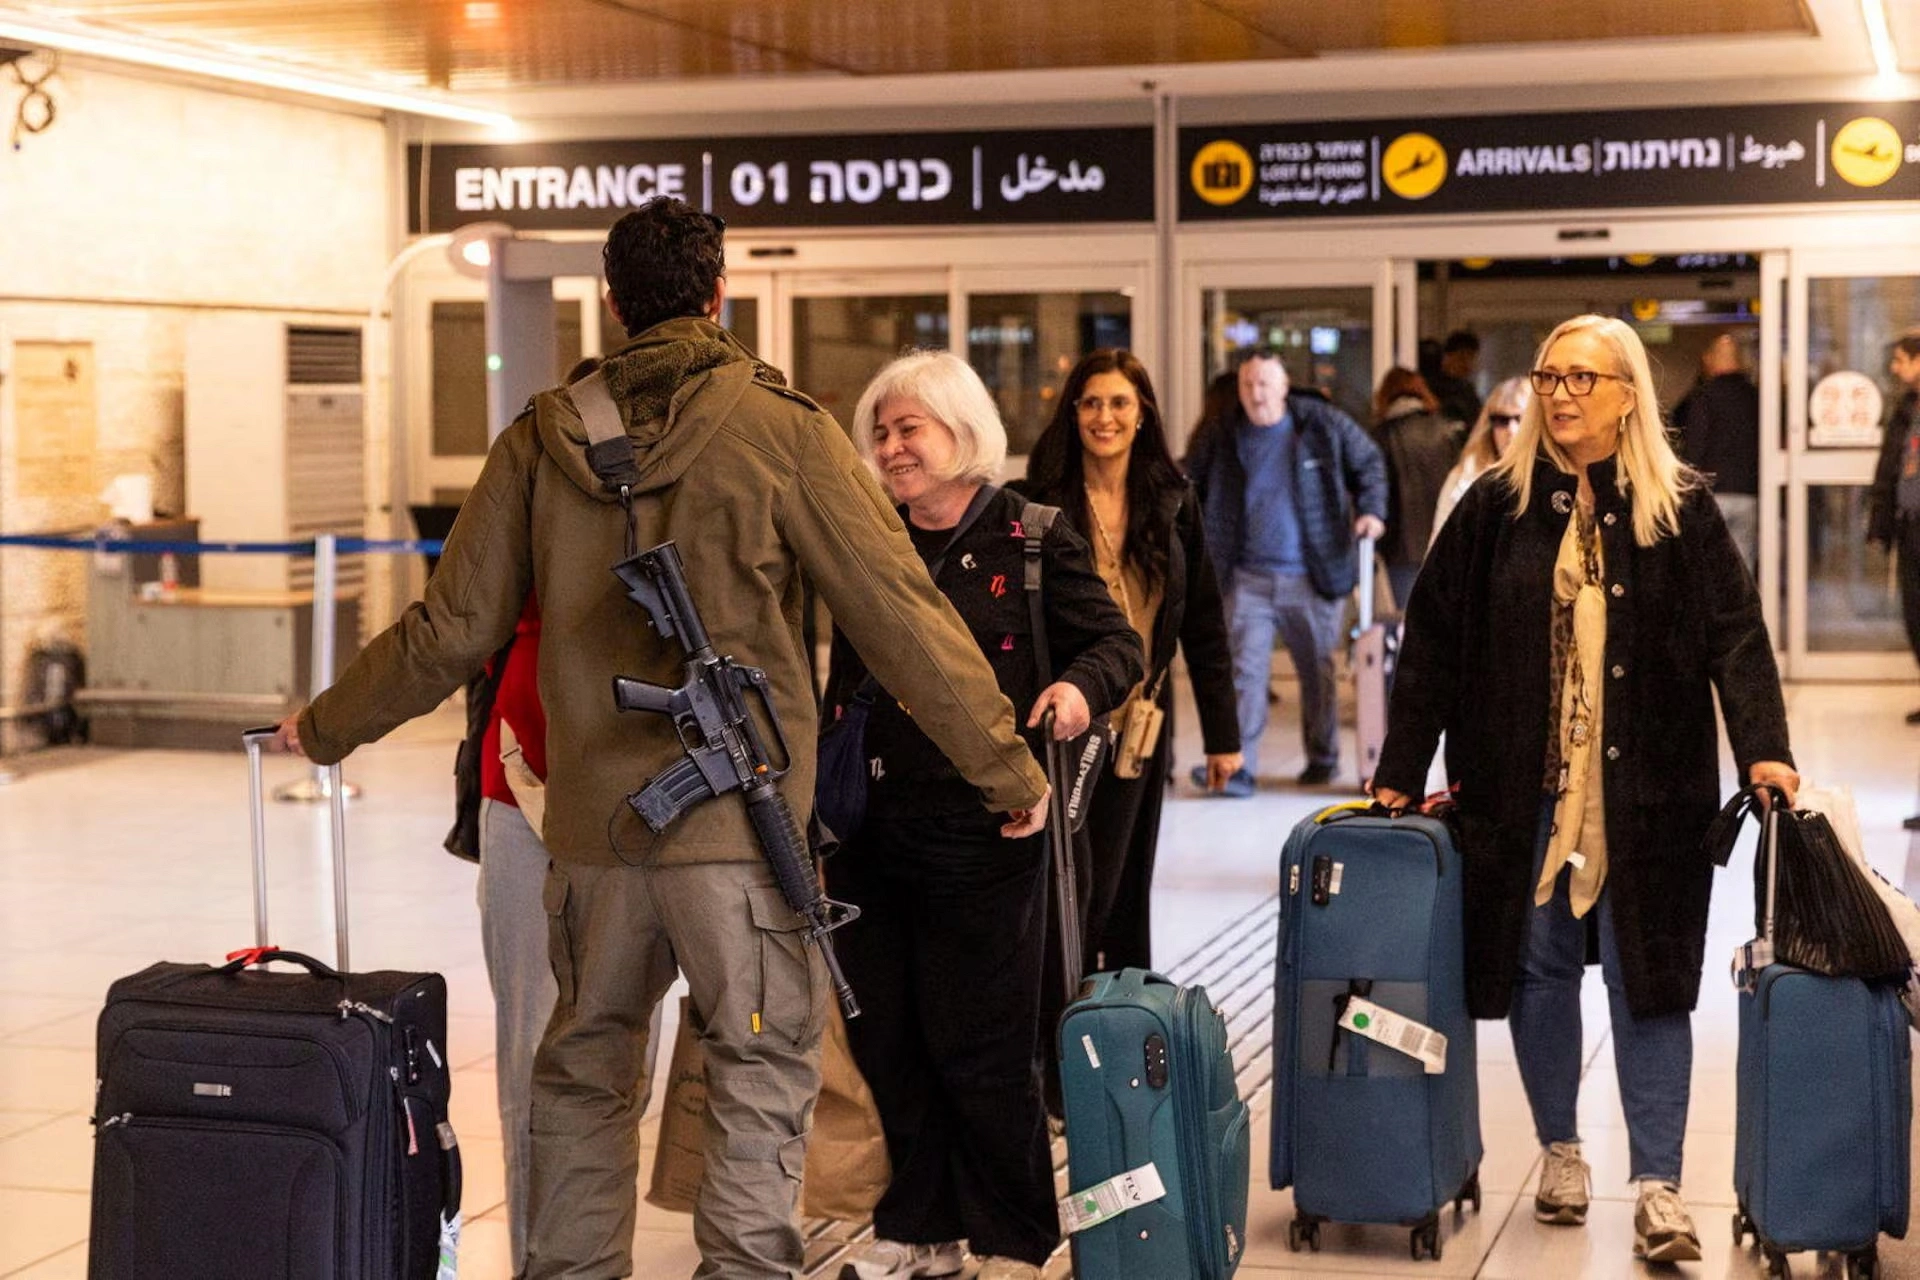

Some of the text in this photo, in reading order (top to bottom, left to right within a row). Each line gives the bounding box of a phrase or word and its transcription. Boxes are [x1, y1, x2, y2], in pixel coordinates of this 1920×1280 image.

[1260, 161, 1366, 181] LOST & FOUND
[1456, 144, 1592, 177] ARRIVALS
[1602, 138, 1721, 172] נחיתות
[455, 164, 686, 211] ENTRANCE
[730, 161, 789, 206] 01
[809, 158, 952, 204] כניסה
[1000, 153, 1106, 202] مدخل
[1125, 1176, 1141, 1201] TLV
